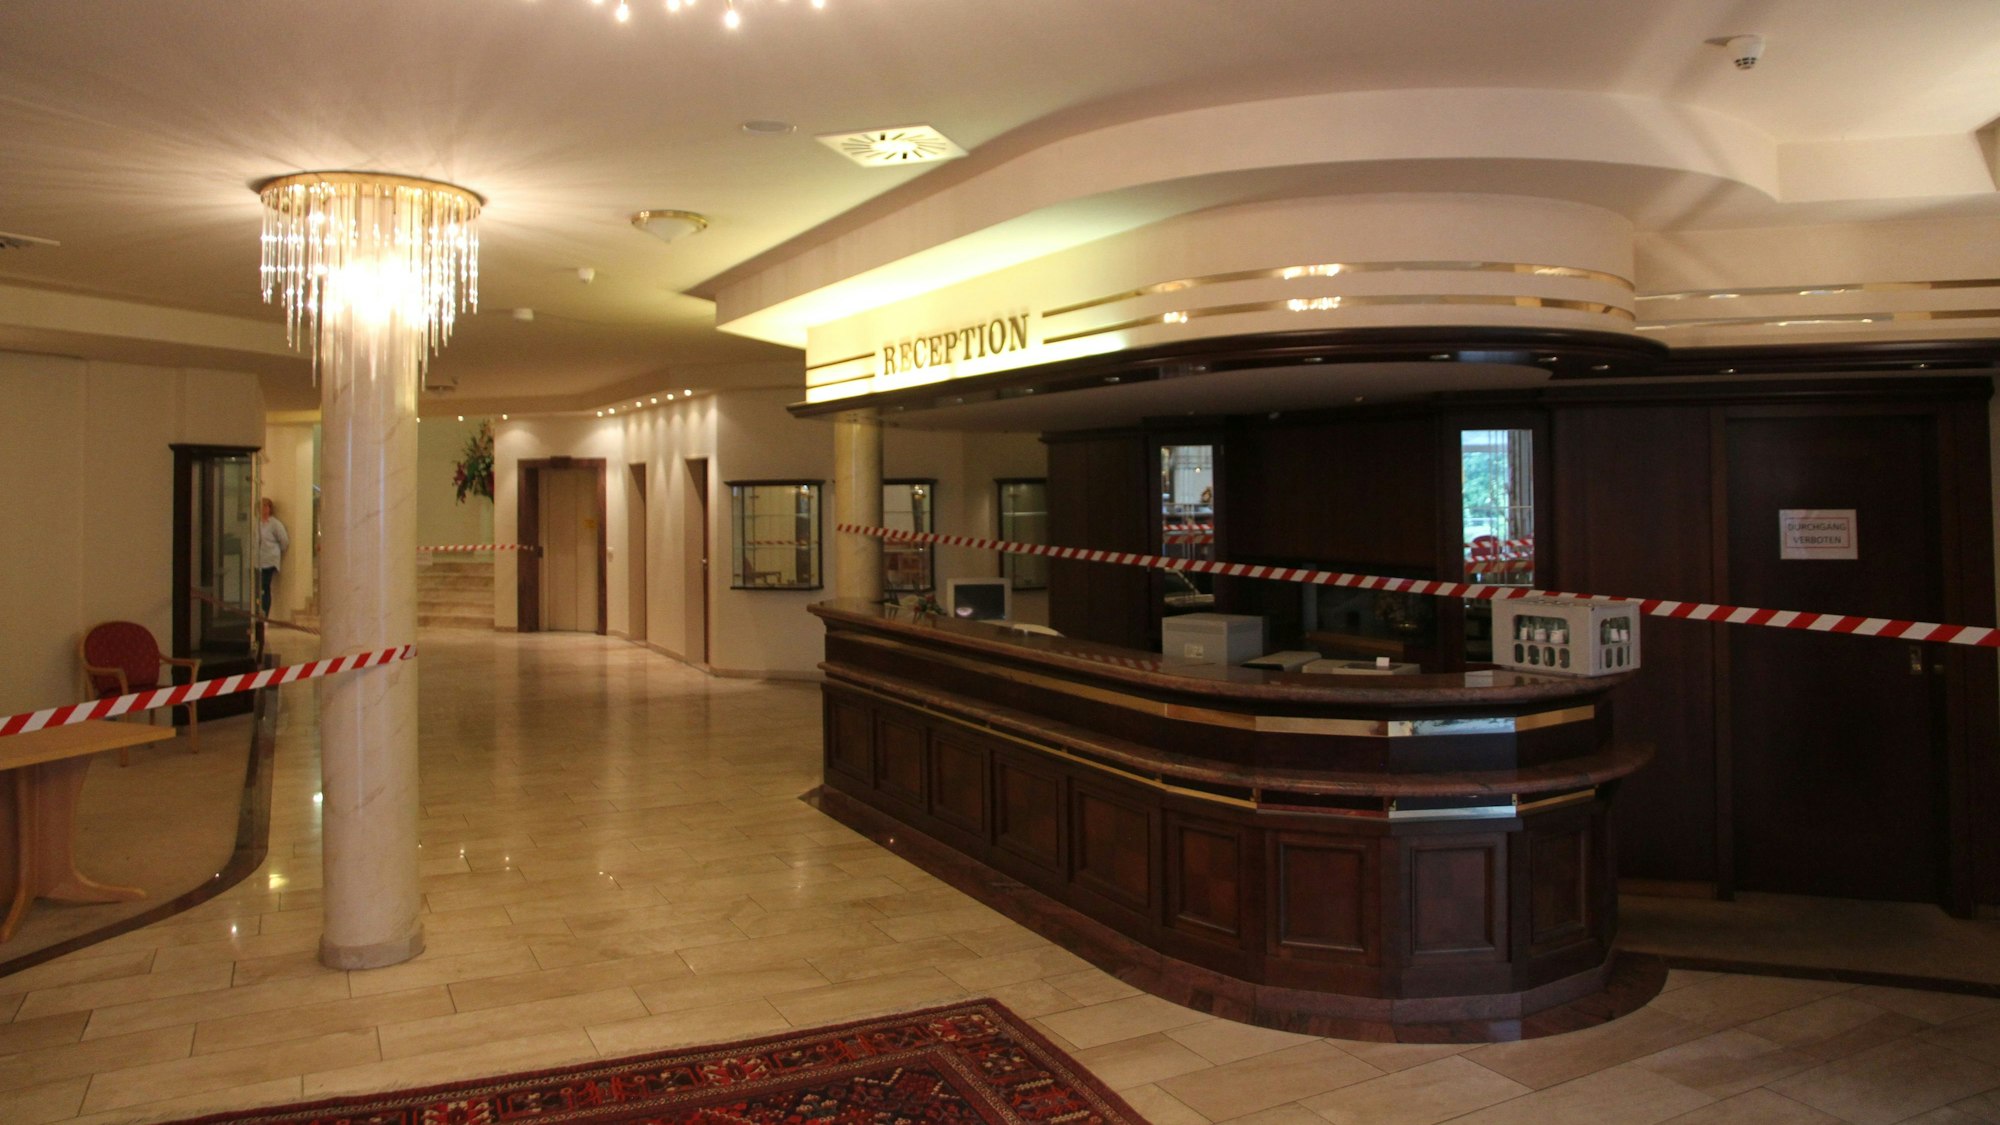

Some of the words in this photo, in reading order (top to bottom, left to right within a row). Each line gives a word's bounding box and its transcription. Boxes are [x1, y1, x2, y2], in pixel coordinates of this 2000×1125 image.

[883, 312, 1029, 376] RECEPTION
[1787, 522, 1846, 531] DURCHGANG
[1793, 535, 1842, 544] VERBOTEN
